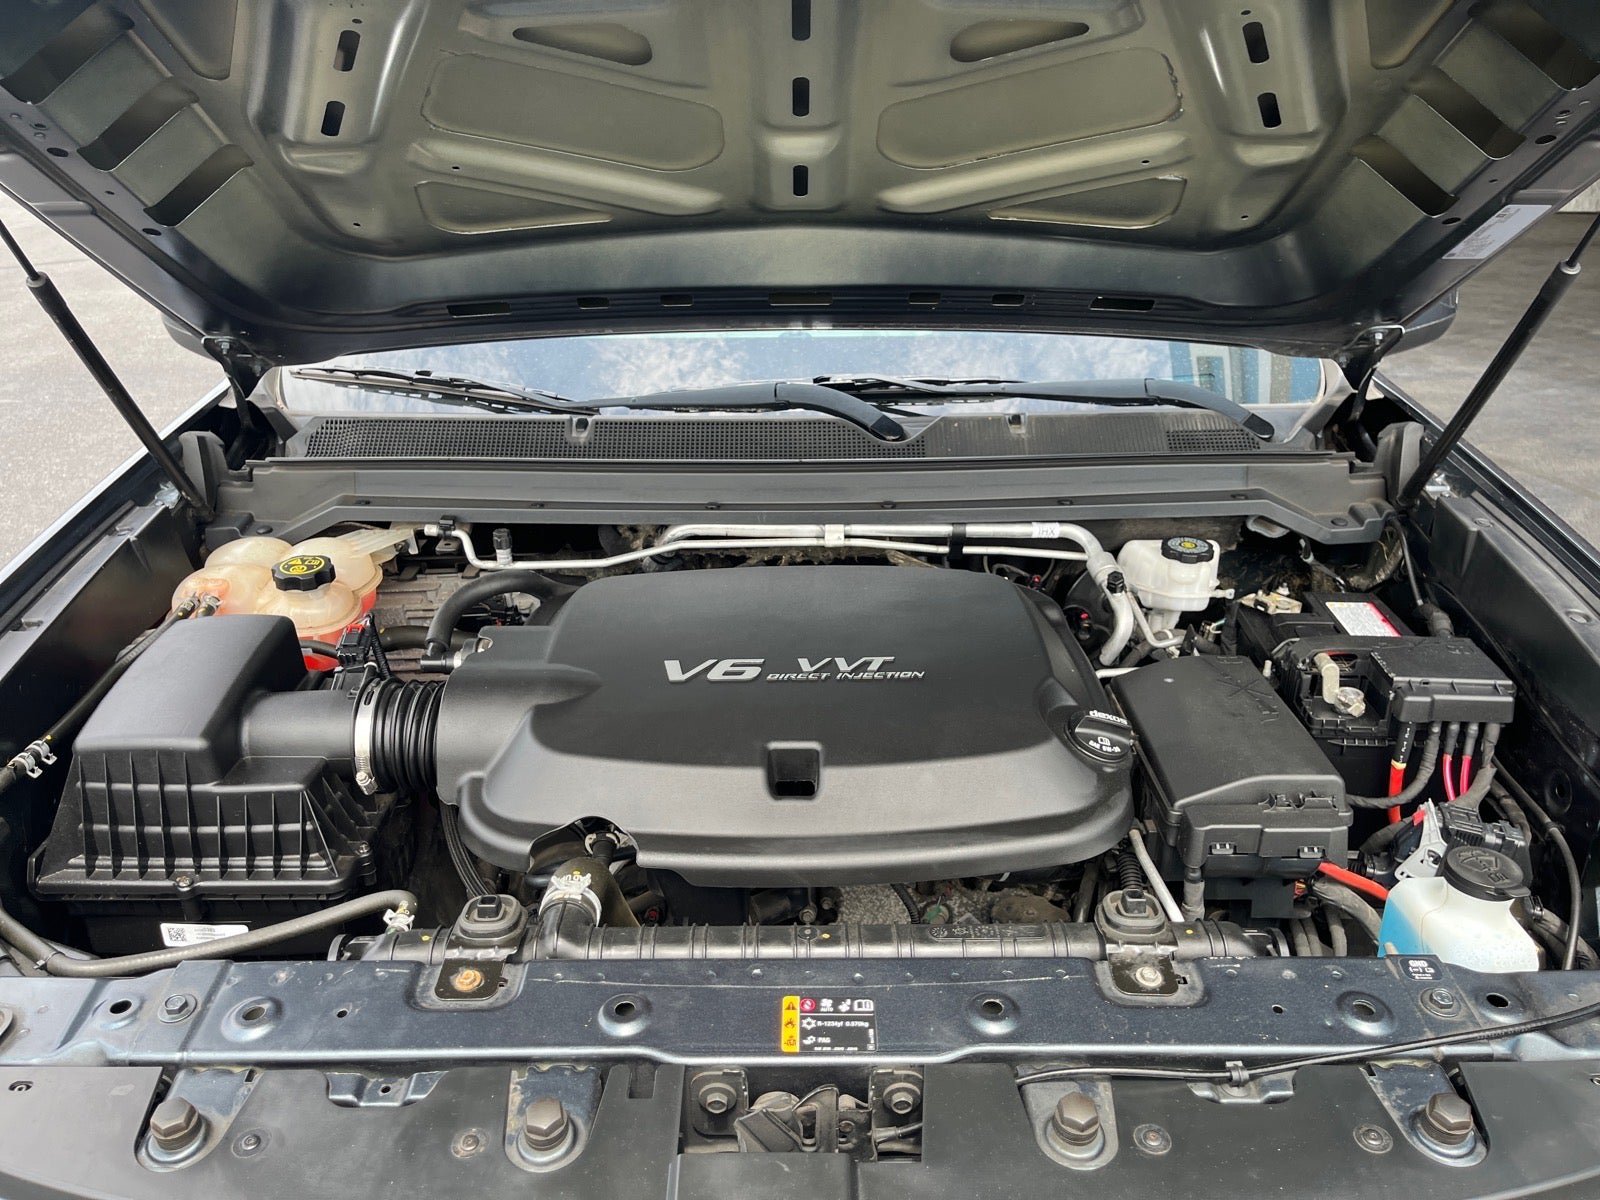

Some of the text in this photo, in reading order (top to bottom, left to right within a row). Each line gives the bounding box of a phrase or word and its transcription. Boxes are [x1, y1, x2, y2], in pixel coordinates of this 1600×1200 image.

[664, 656, 896, 682] V6 VVT
[766, 671, 925, 681] DIRECT INJECTION
[1089, 710, 1128, 725] dexos
[817, 1020, 843, 1028] R-1234yf
[817, 1036, 832, 1044] PAG
